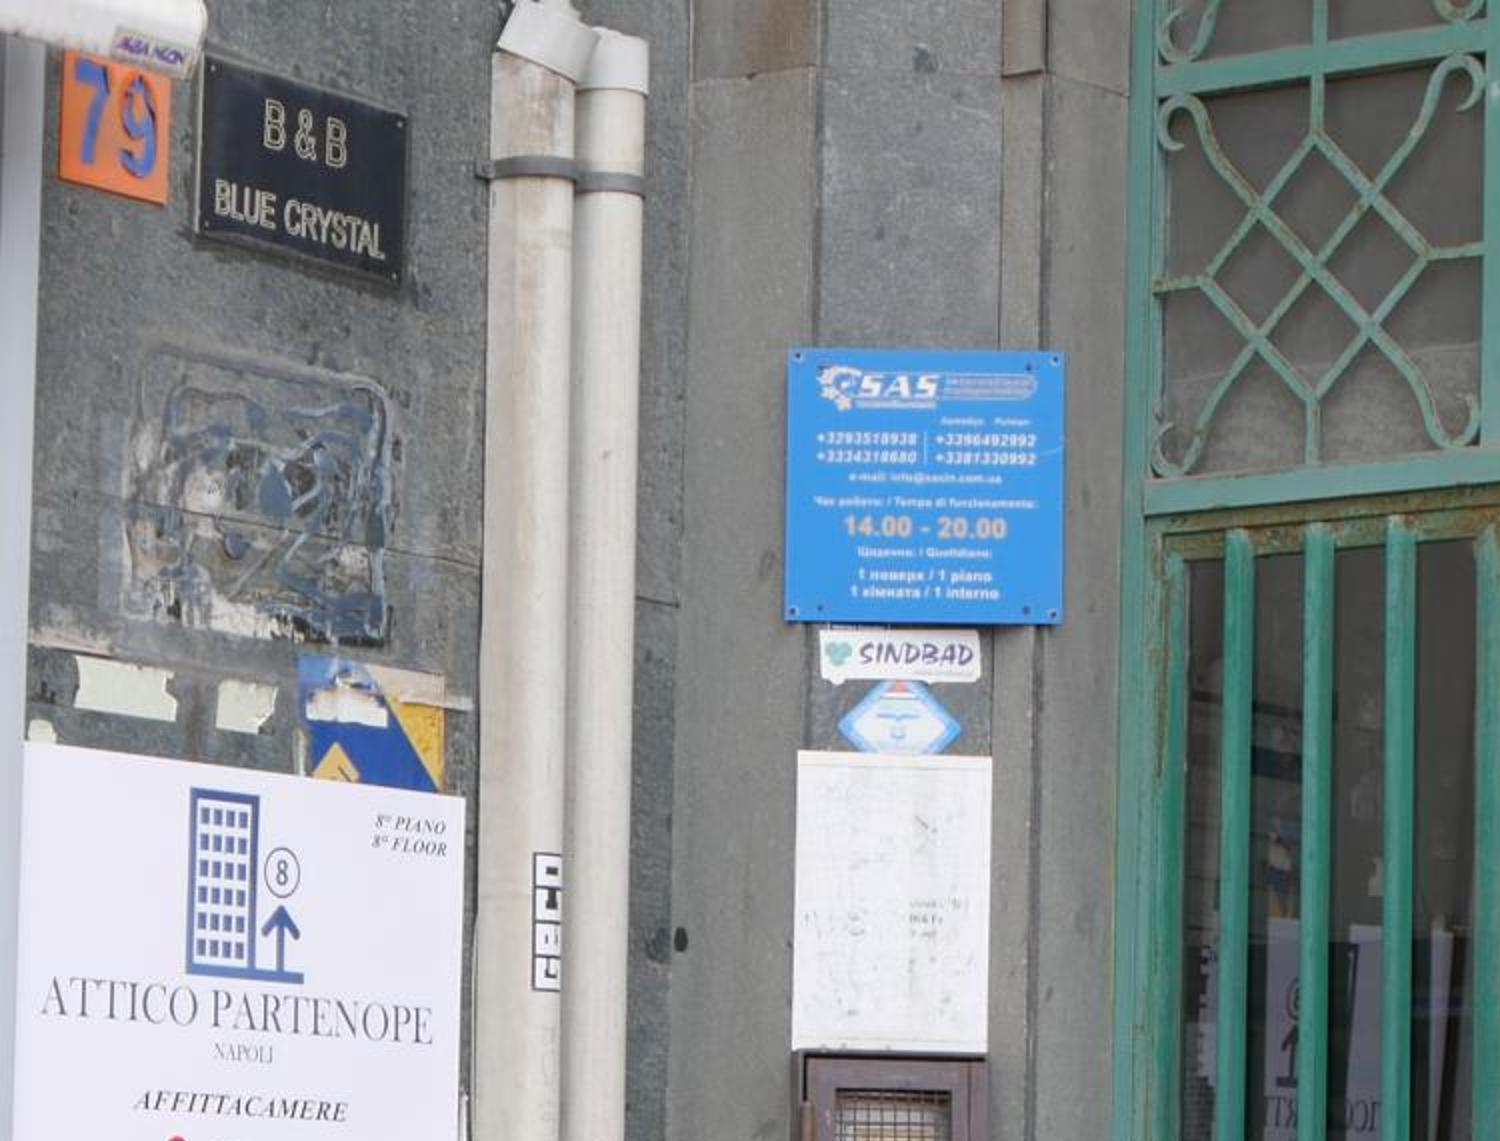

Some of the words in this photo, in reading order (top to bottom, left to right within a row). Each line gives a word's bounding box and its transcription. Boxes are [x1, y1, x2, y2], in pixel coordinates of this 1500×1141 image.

[74, 58, 157, 180] 79
[264, 99, 286, 151] B
[294, 109, 317, 161] &
[325, 116, 348, 168] B
[214, 179, 278, 230] BLUE
[284, 199, 386, 260] CRYSTAL
[844, 513, 913, 538] 14.00
[938, 515, 1008, 540] 20.00
[950, 569, 993, 585] piano
[945, 586, 1000, 601] interno
[859, 640, 973, 666] SINDBAD
[395, 815, 447, 835] PIANO
[392, 836, 448, 857] FLOOR
[275, 858, 289, 886] 8
[40, 975, 198, 1027] ATTICO
[211, 989, 434, 1044] PARTENOPE
[212, 1042, 274, 1065] NAPOLI
[135, 1089, 350, 1123] AFFITTACAMERE
